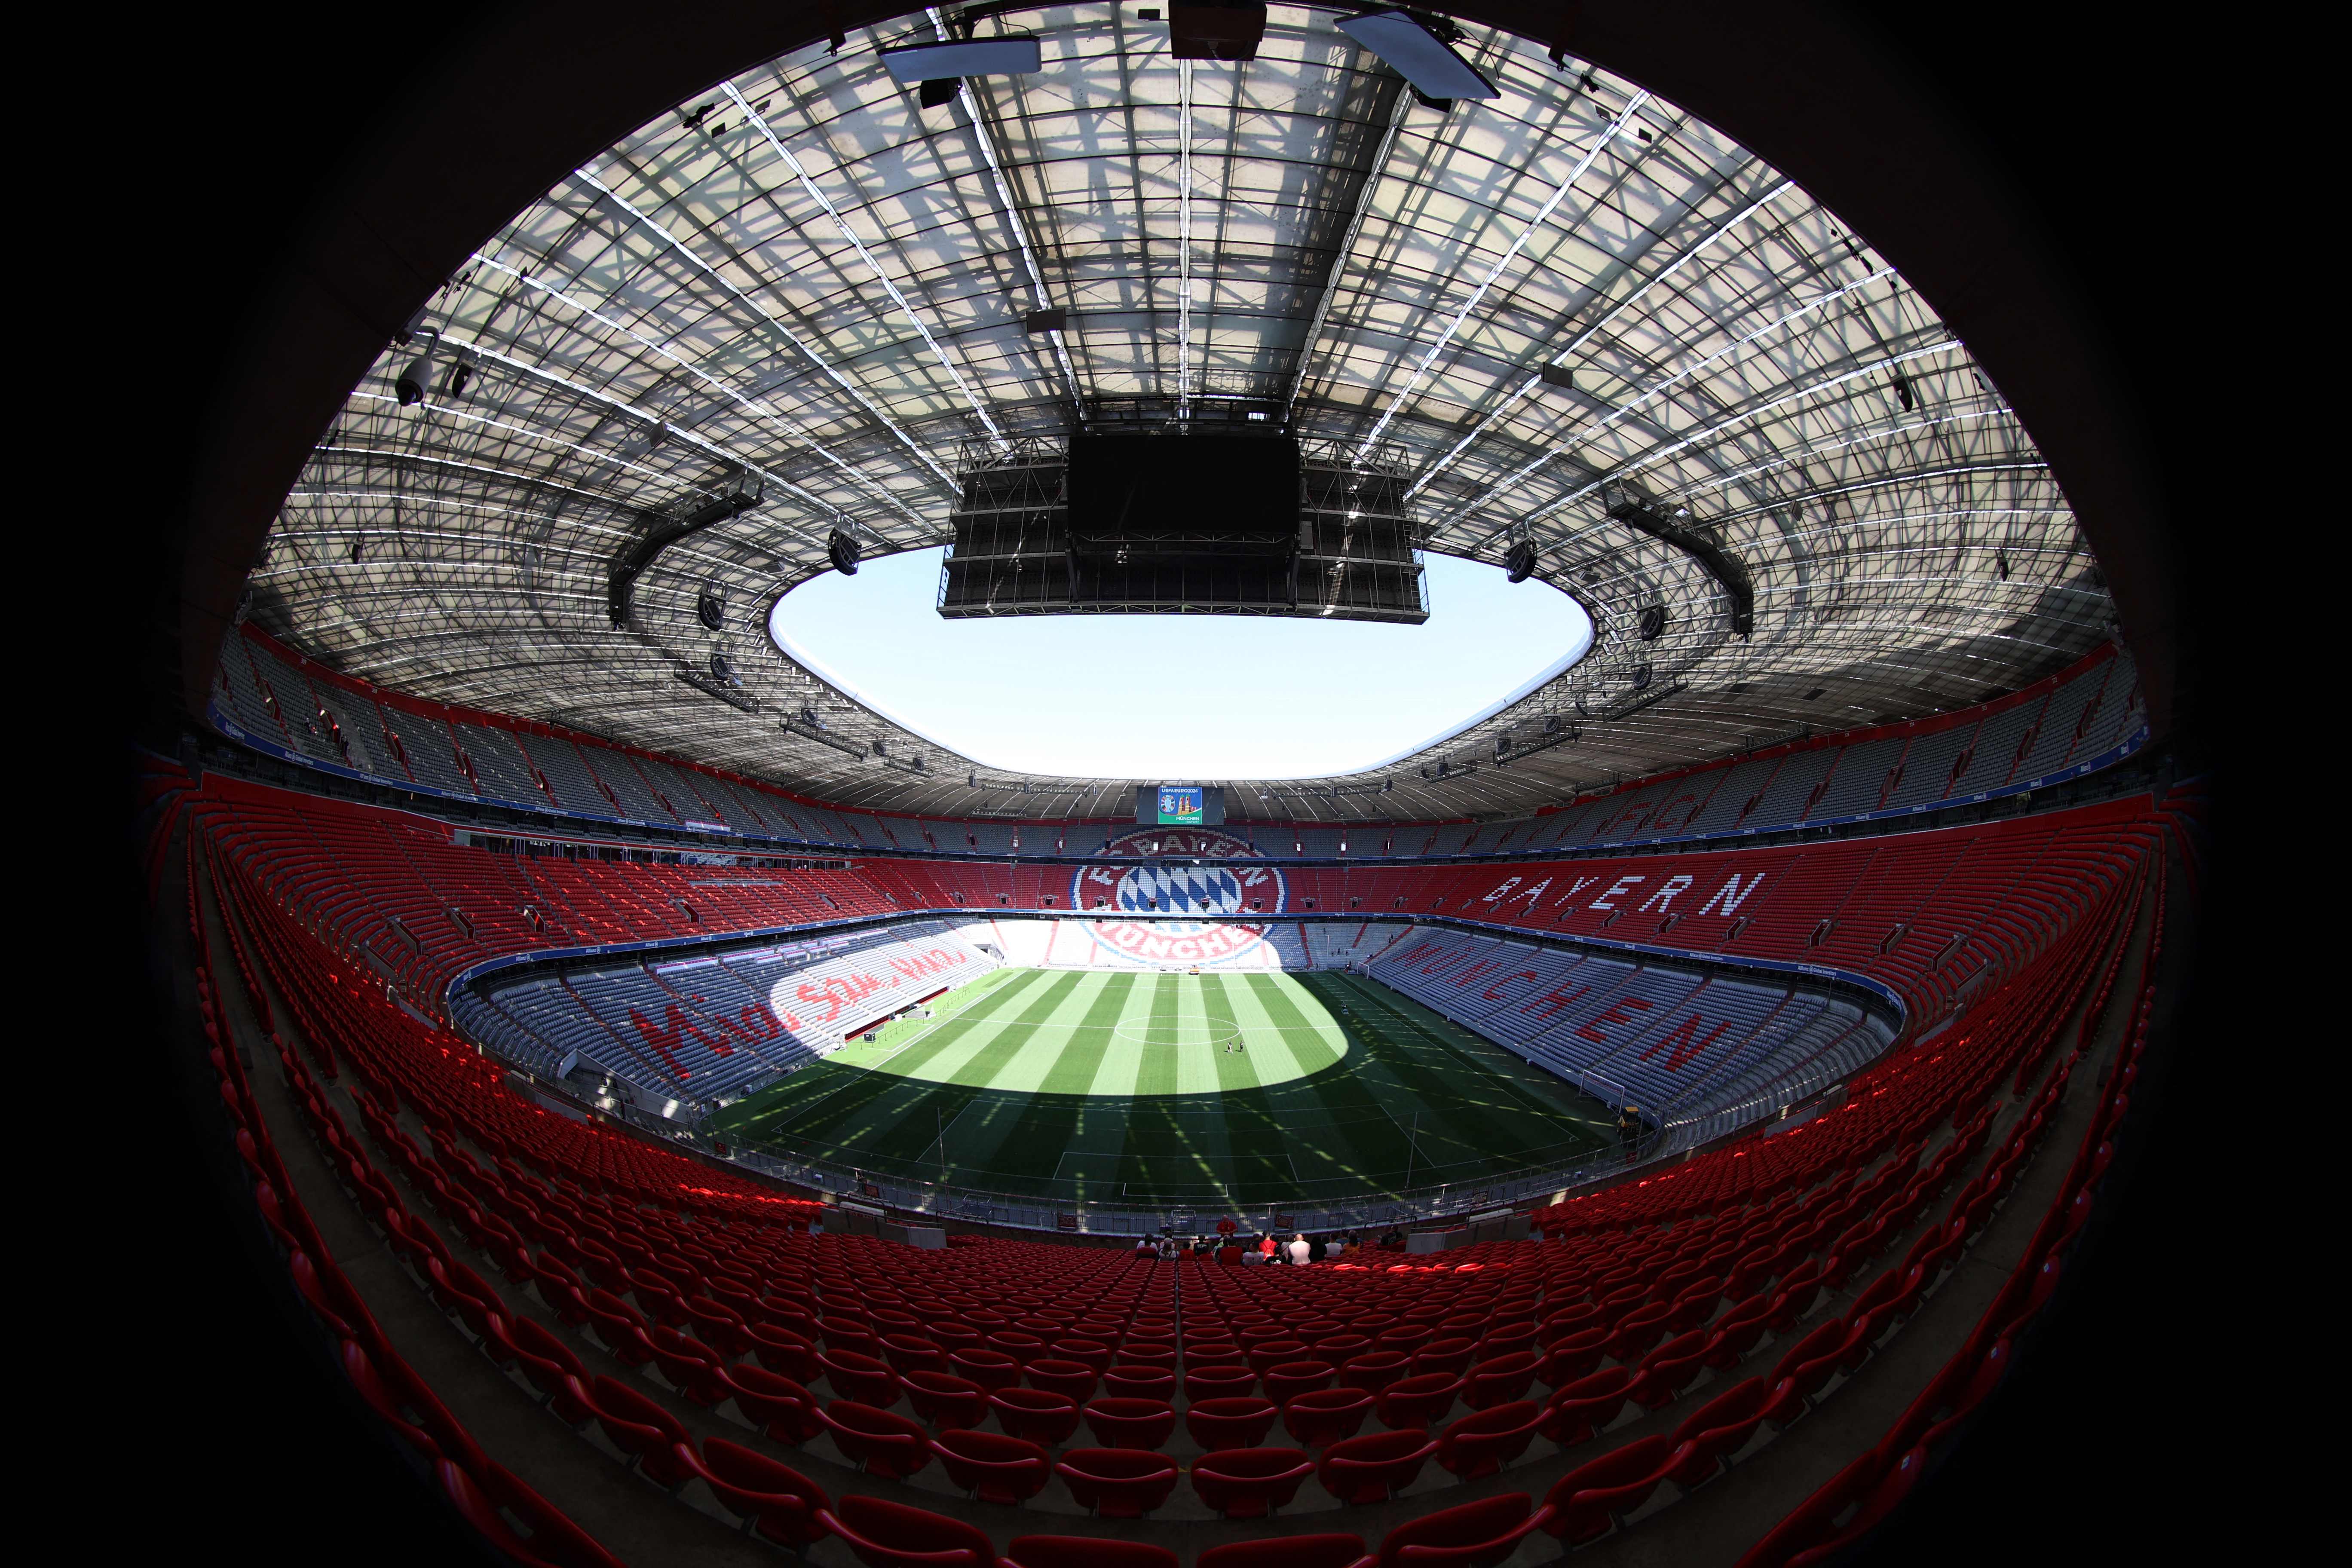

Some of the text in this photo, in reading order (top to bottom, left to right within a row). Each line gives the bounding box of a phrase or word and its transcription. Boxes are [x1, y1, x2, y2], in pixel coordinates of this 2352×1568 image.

[1605, 795, 1695, 835] FC
[1482, 873, 1766, 916] BAYERN
[1393, 943, 1731, 1072] MÜNCHEN
